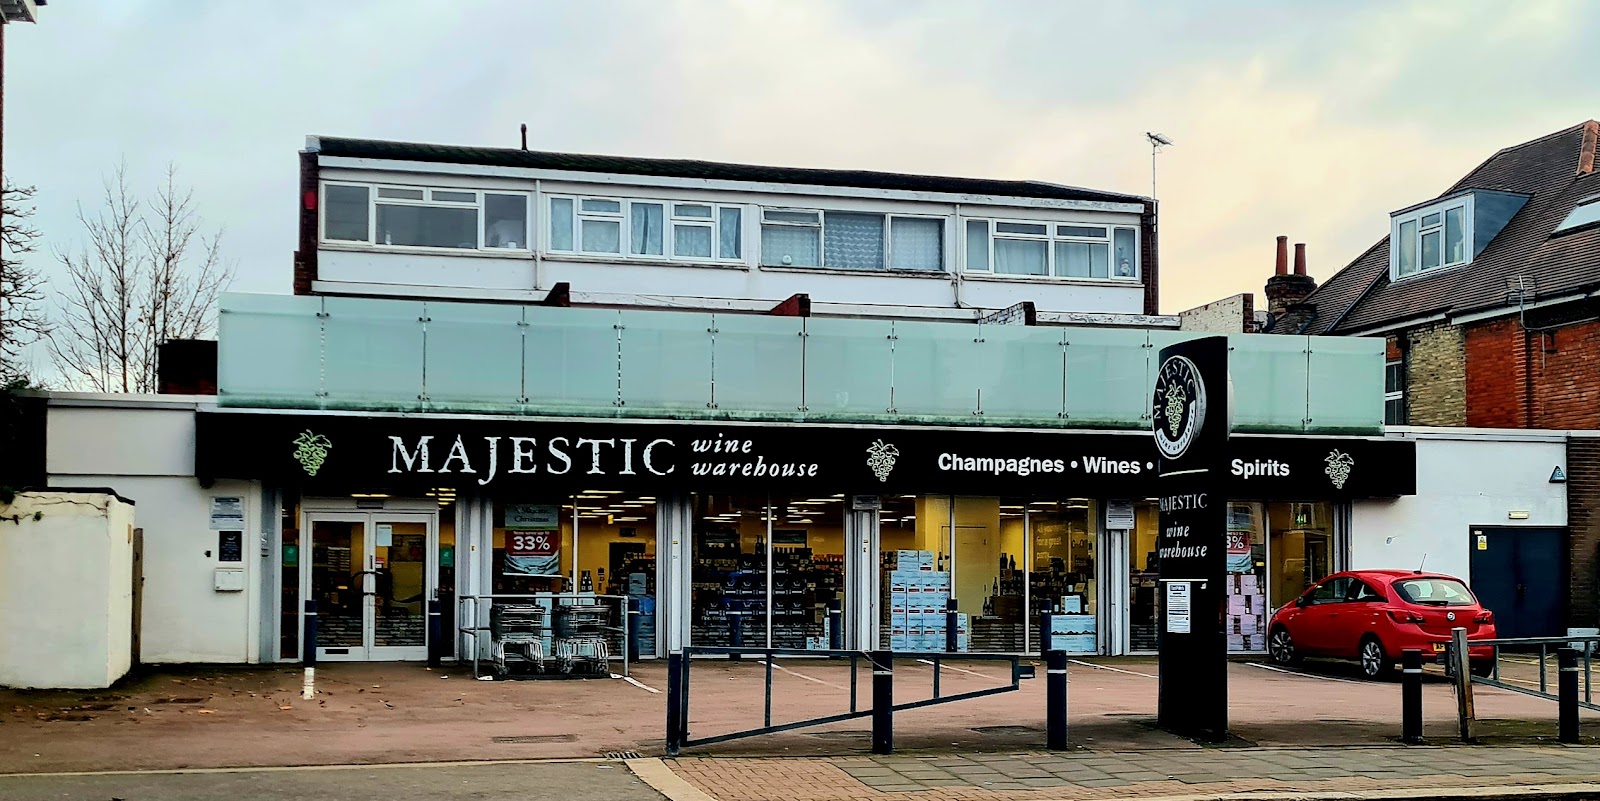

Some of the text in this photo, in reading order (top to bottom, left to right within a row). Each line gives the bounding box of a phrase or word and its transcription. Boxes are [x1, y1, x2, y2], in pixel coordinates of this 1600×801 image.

[1154, 360, 1194, 419] MAJESTIC
[690, 433, 753, 454] wine
[387, 433, 676, 486] MAJESTIC
[690, 456, 819, 477] warehouse
[938, 453, 1290, 480] Champagnes Wines Spirits
[1160, 493, 1208, 515] MAJESTIC
[1166, 521, 1190, 538] wine
[513, 535, 551, 551] 33%
[1159, 541, 1208, 559] warehouse
[1226, 536, 1244, 549] 3%
